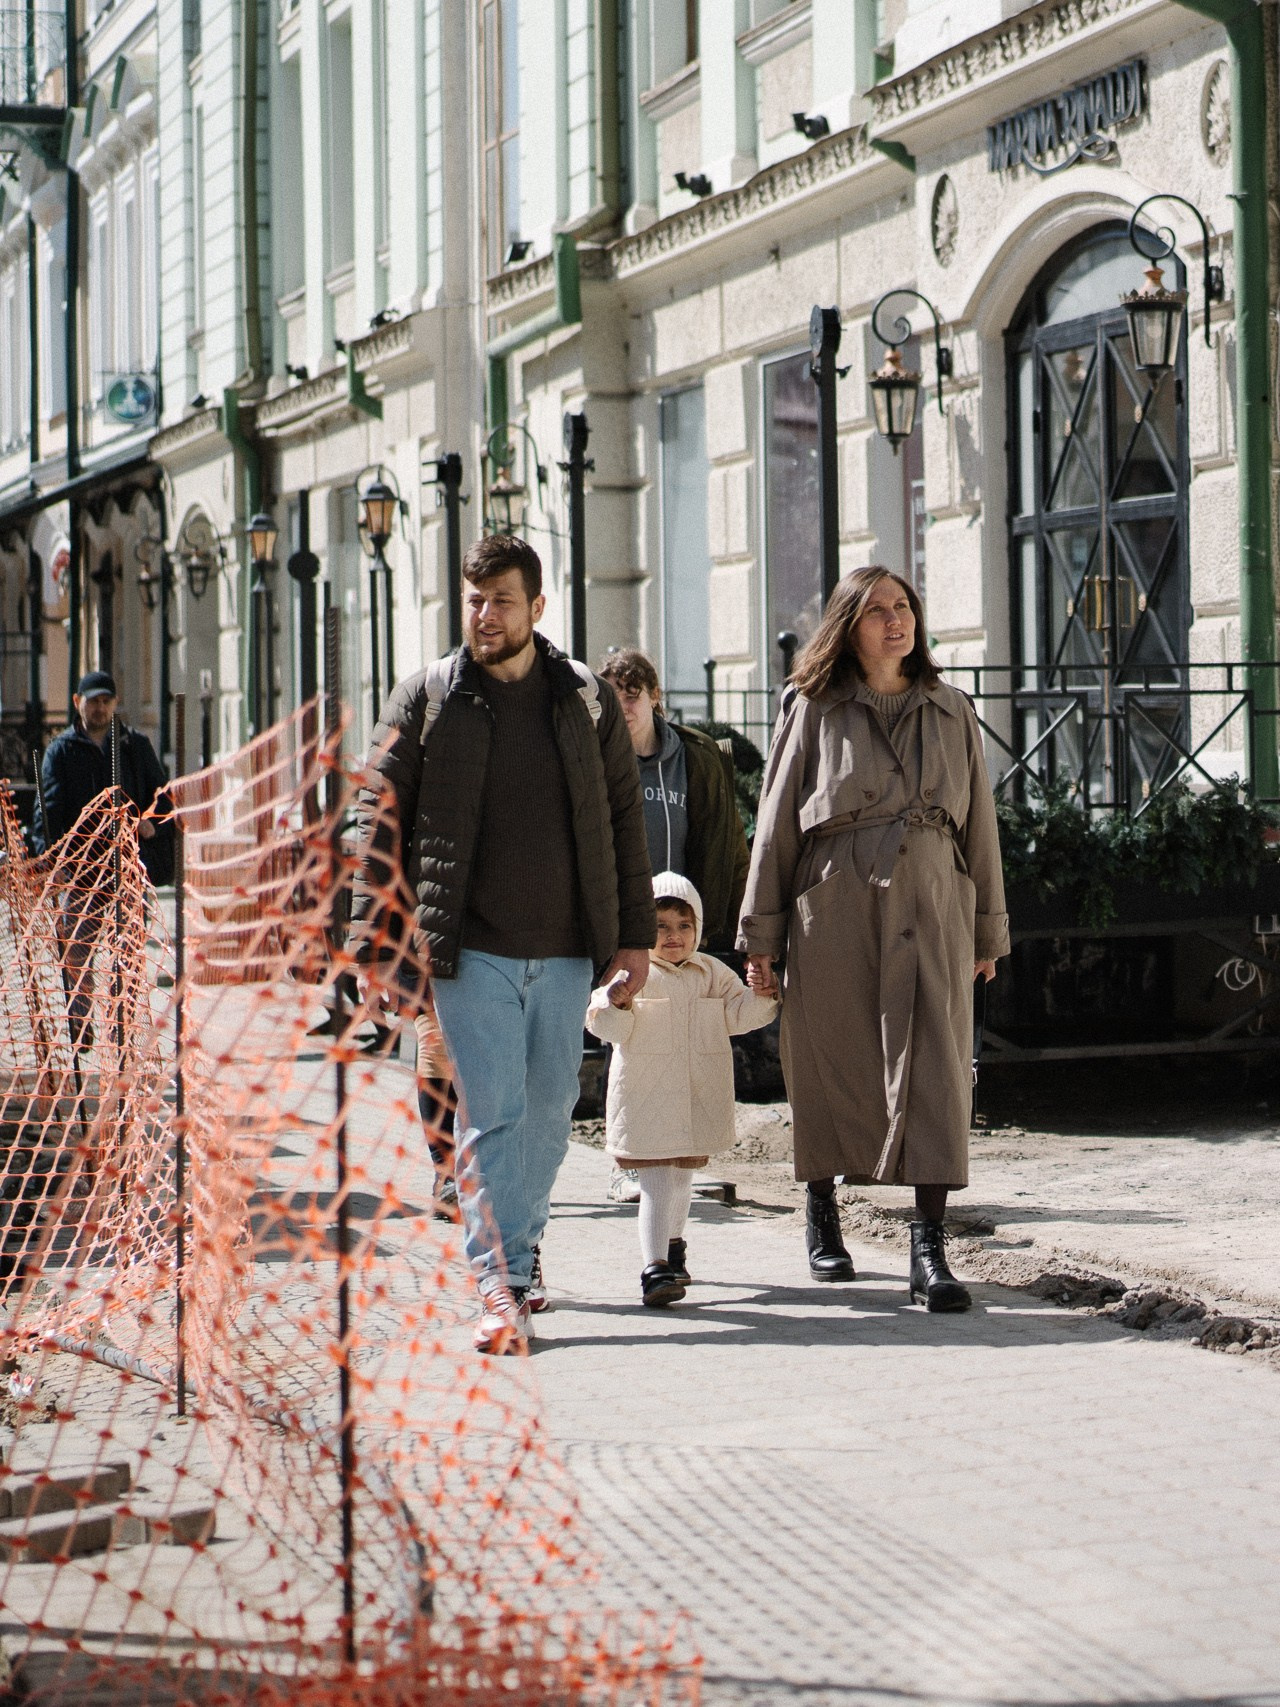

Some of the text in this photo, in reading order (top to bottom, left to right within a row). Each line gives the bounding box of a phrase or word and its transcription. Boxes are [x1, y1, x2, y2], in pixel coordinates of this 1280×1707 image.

[986, 60, 1142, 174] MARINA RINALDI
[644, 786, 687, 810] ORNI
